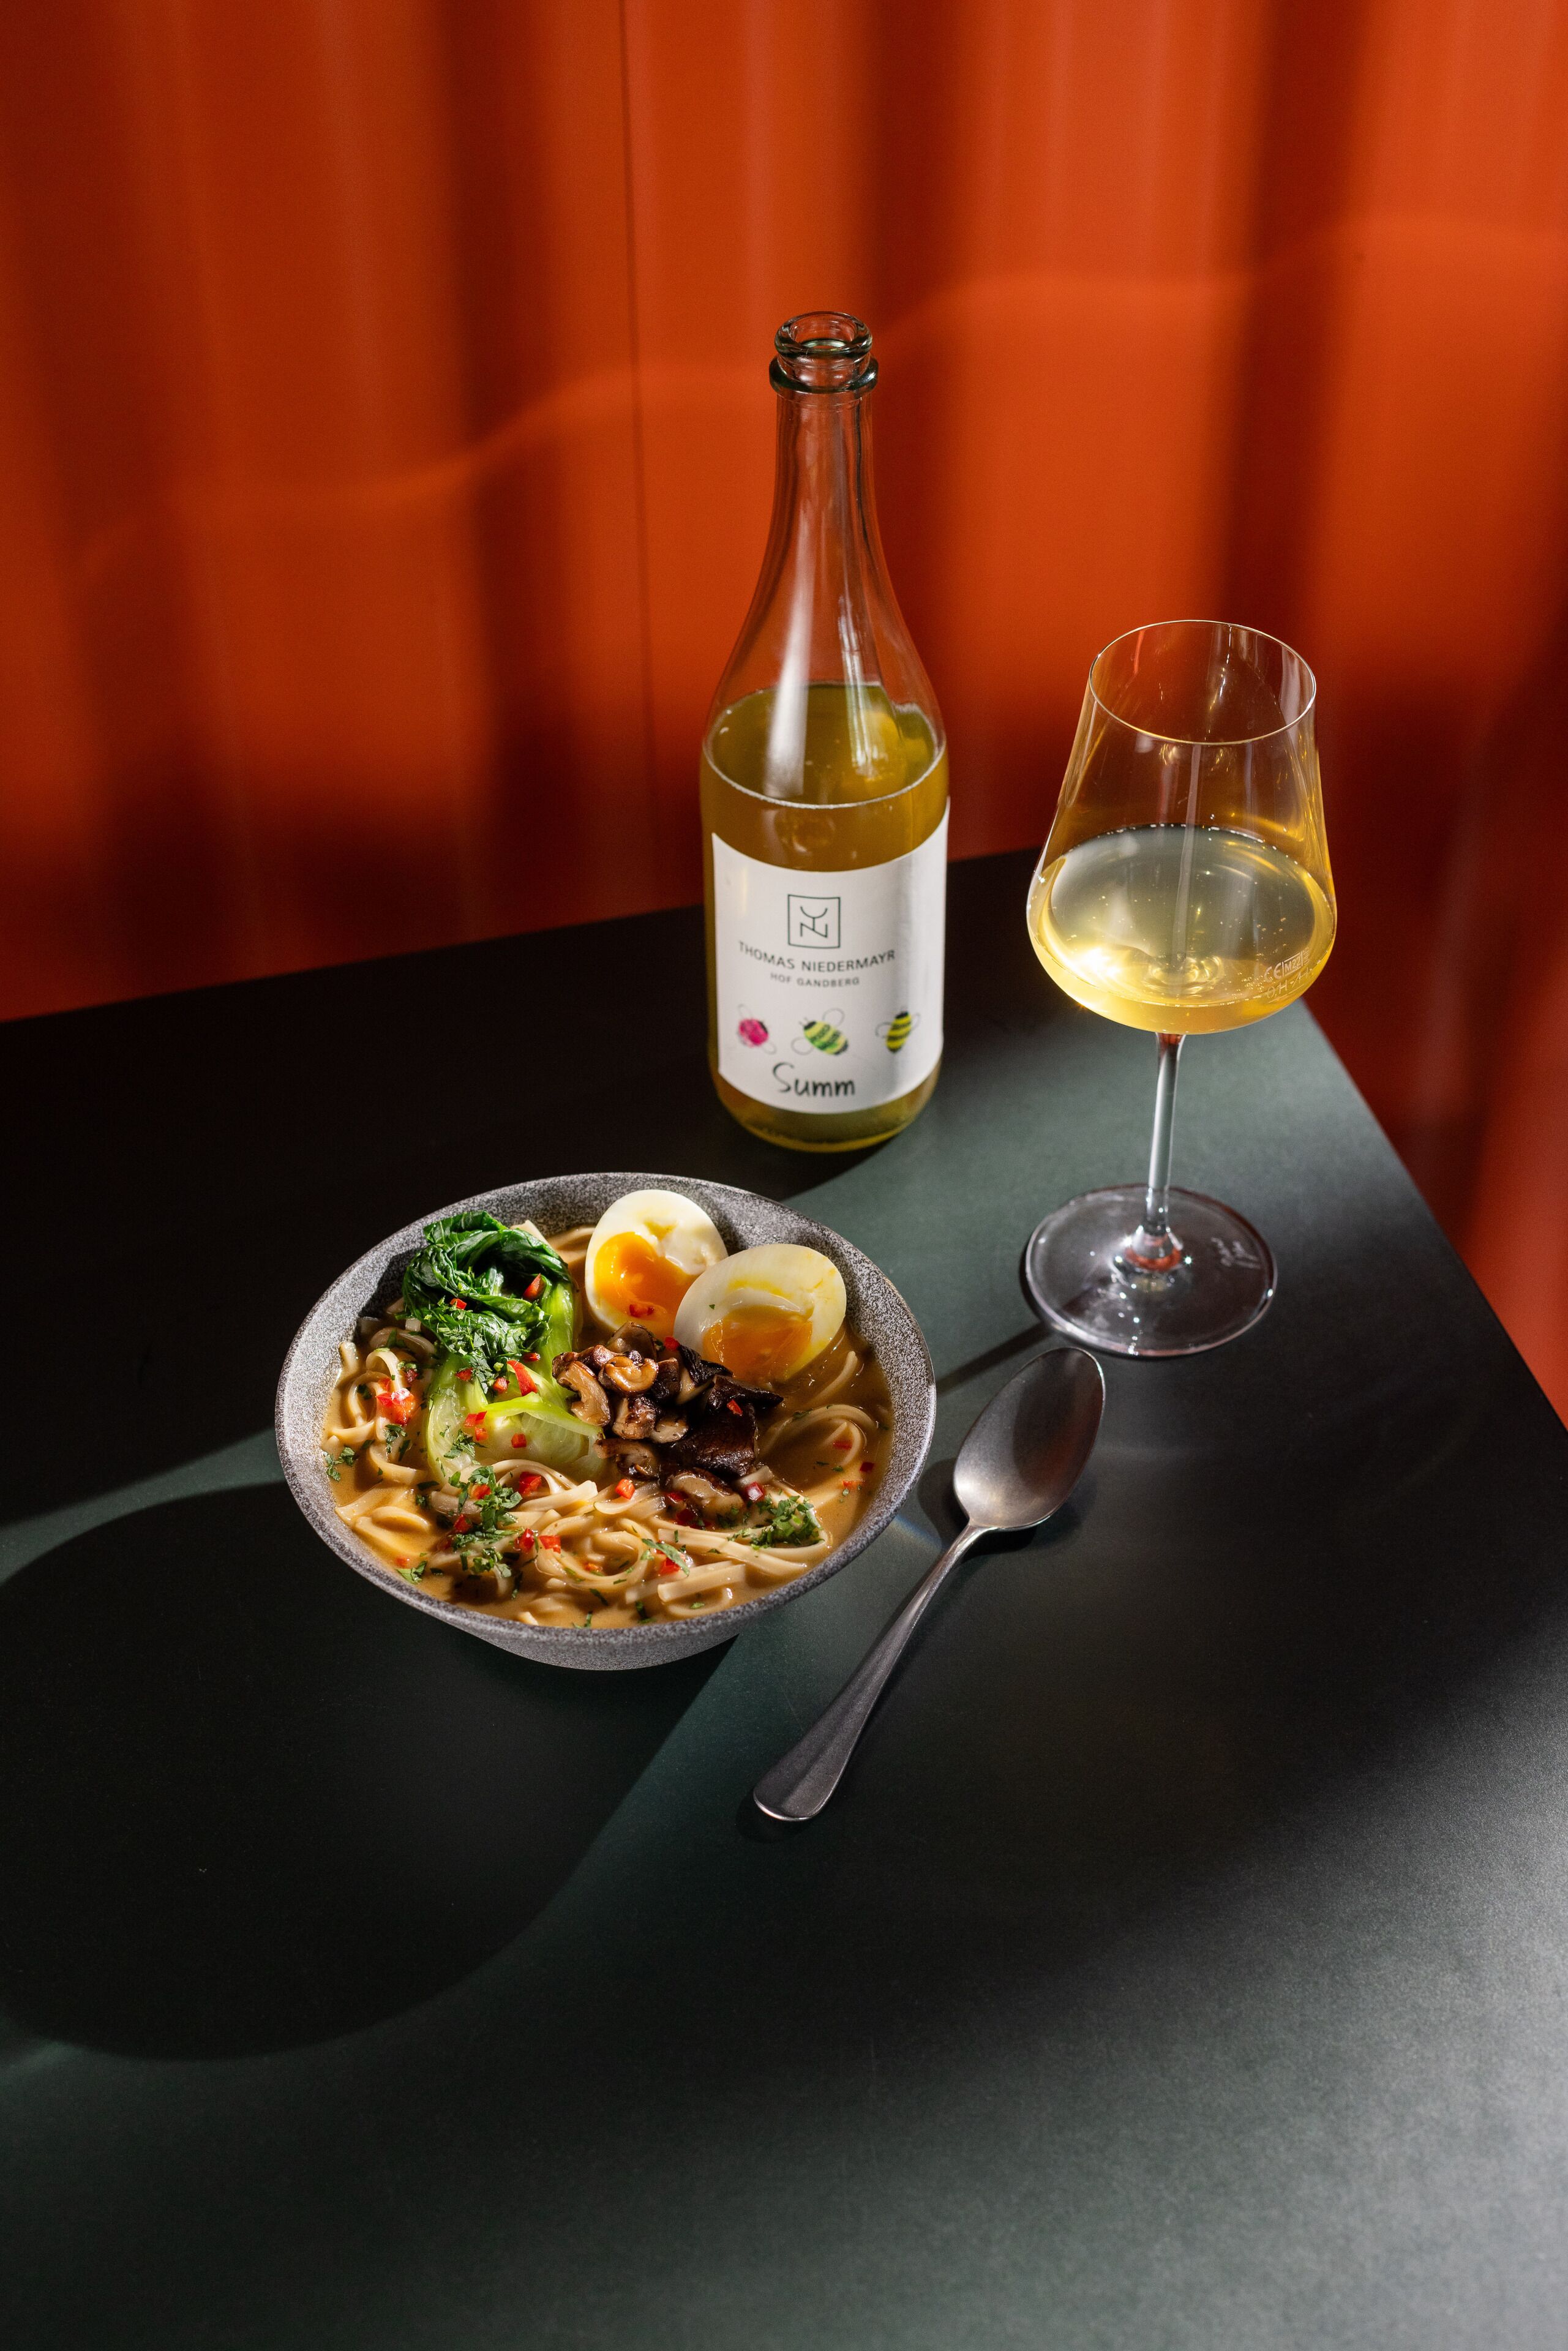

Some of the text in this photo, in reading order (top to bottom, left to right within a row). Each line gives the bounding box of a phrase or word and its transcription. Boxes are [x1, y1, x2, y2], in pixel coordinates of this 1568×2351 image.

[738, 940, 896, 973] THOMAS NIEDERMAYR
[770, 972, 860, 988] HOF GANDBERG
[771, 1061, 856, 1097] Summ
